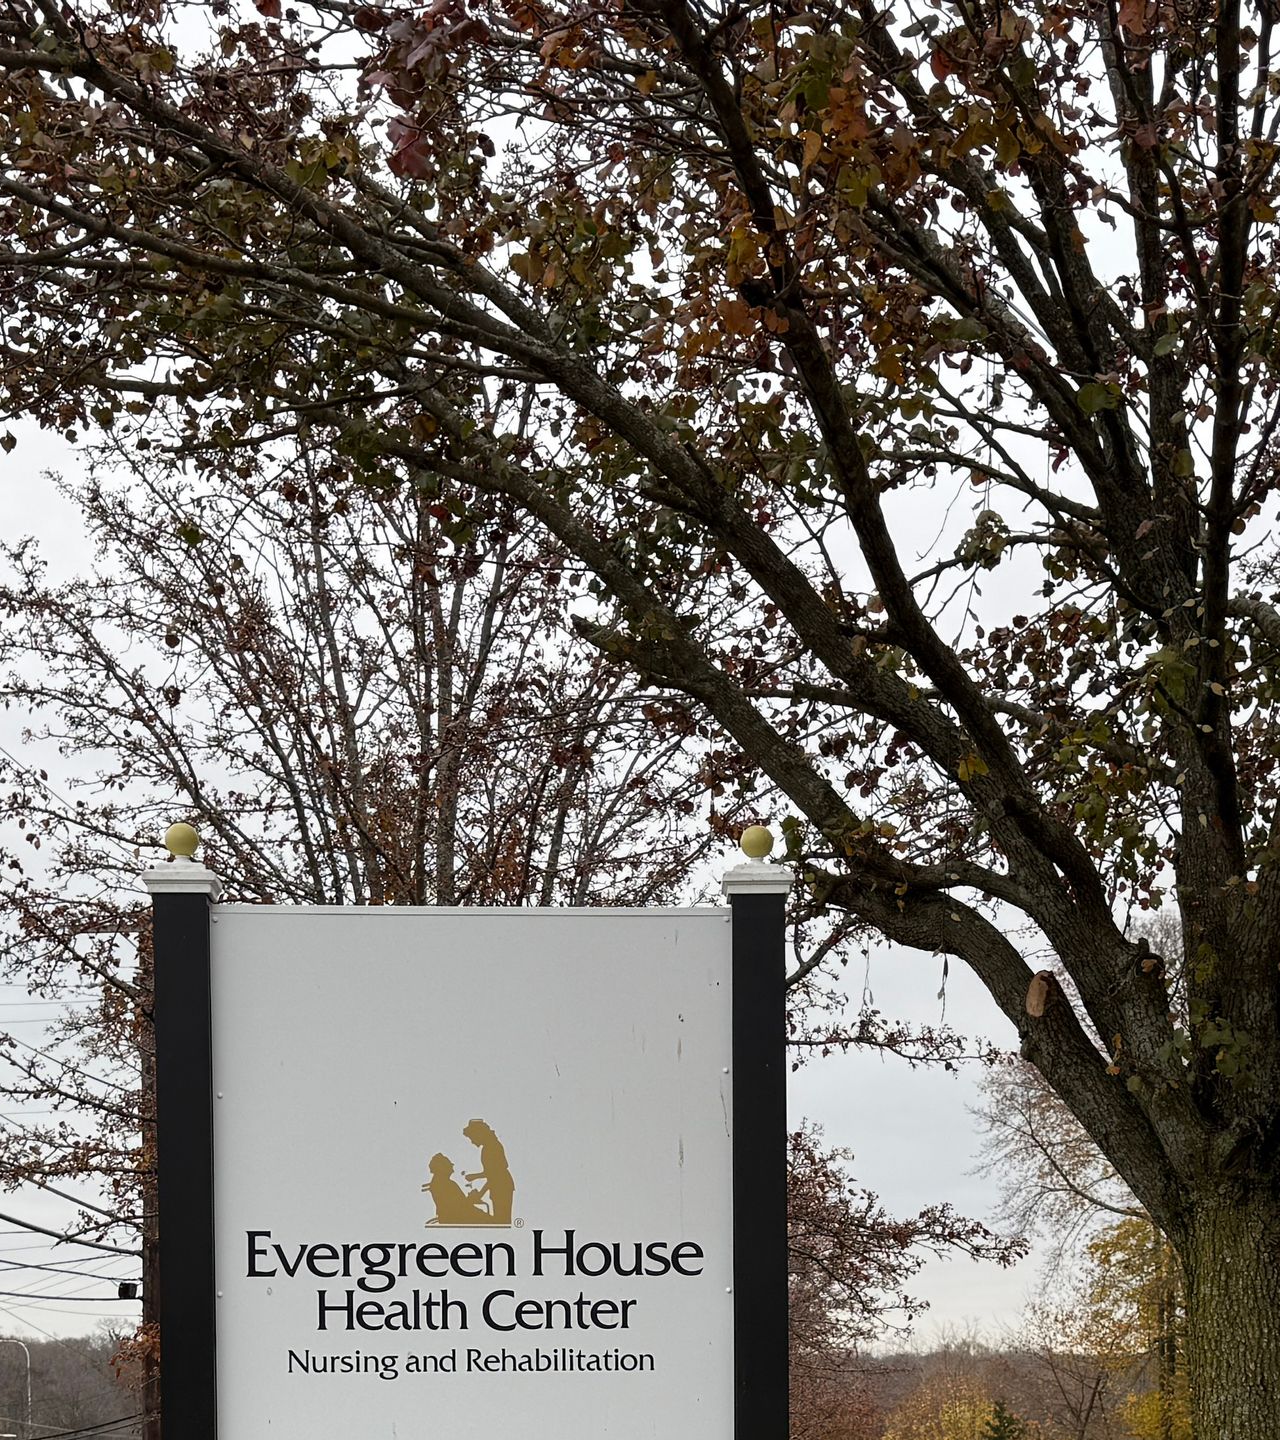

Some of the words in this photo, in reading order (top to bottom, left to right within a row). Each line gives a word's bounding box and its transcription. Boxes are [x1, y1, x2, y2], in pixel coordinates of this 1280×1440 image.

[245, 1230, 517, 1294] Evergreen
[532, 1229, 704, 1277] House
[317, 1289, 469, 1331] Health
[482, 1288, 638, 1332] Center
[287, 1349, 399, 1381] Nursing
[405, 1348, 457, 1373] and
[466, 1347, 656, 1373] Rehabilitation
